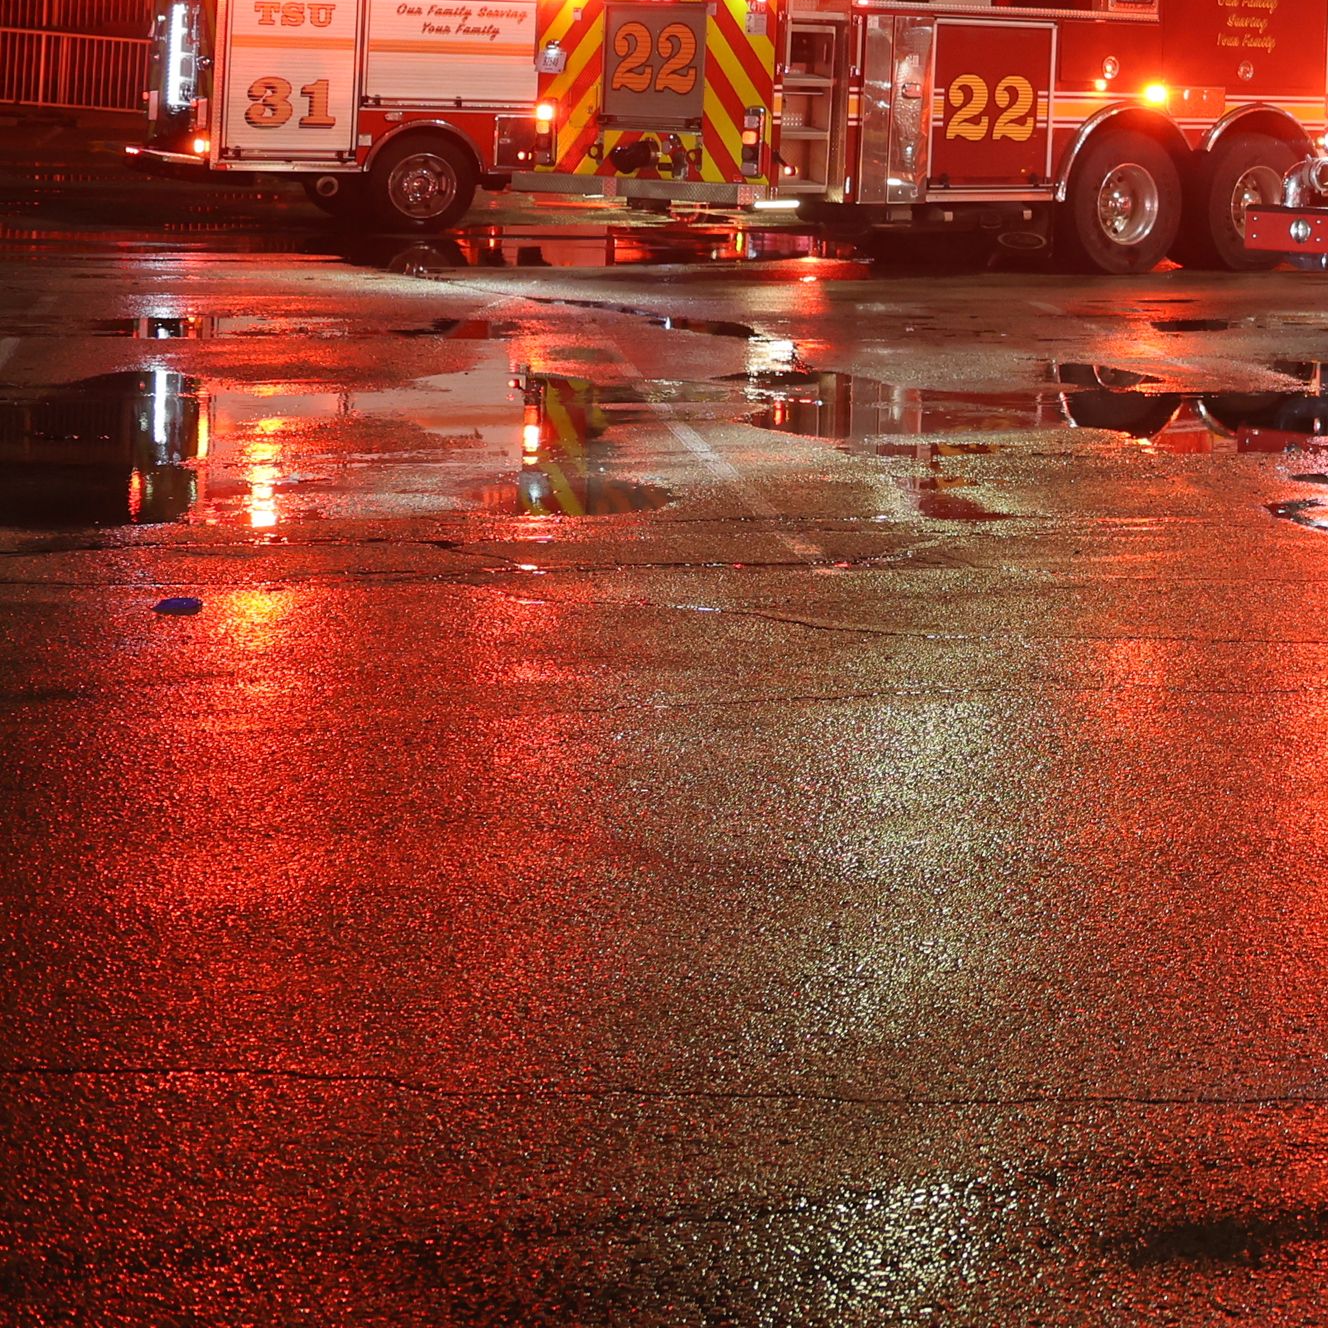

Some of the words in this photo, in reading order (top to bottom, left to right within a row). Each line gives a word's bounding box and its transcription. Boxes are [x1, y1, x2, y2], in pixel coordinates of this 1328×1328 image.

[254, 1, 336, 28] TSU
[396, 3, 423, 16] Our
[426, 4, 472, 22] Family
[477, 6, 528, 24] Serving
[421, 22, 451, 35] Your
[455, 23, 500, 41] Family
[611, 21, 697, 95] 22
[245, 77, 336, 129] 31
[946, 74, 1034, 141] 22
